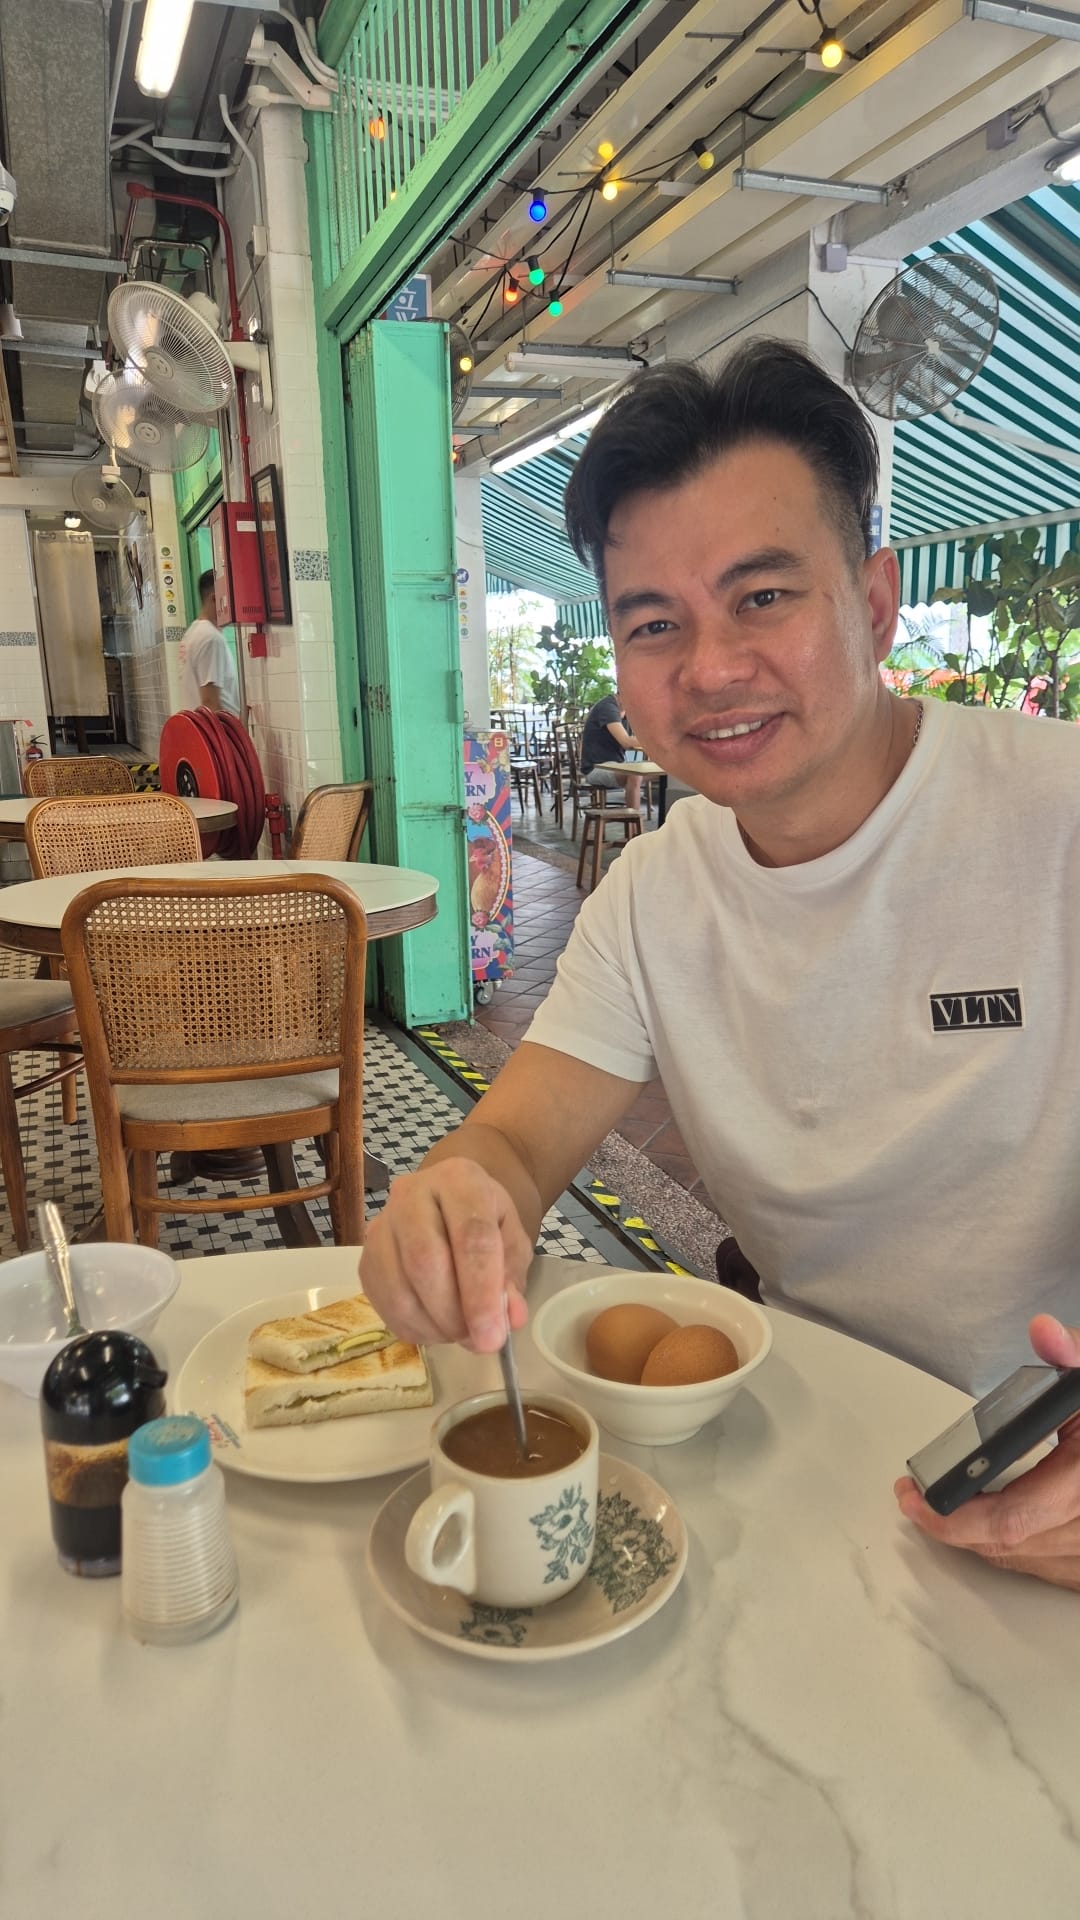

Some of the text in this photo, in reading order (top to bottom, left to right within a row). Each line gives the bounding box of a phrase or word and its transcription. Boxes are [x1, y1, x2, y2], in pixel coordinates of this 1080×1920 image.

[464, 771, 473, 783] Y
[465, 784, 486, 797] RN
[470, 935, 478, 946] Y
[471, 947, 490, 959] RN
[930, 992, 1020, 1027] VLTN
